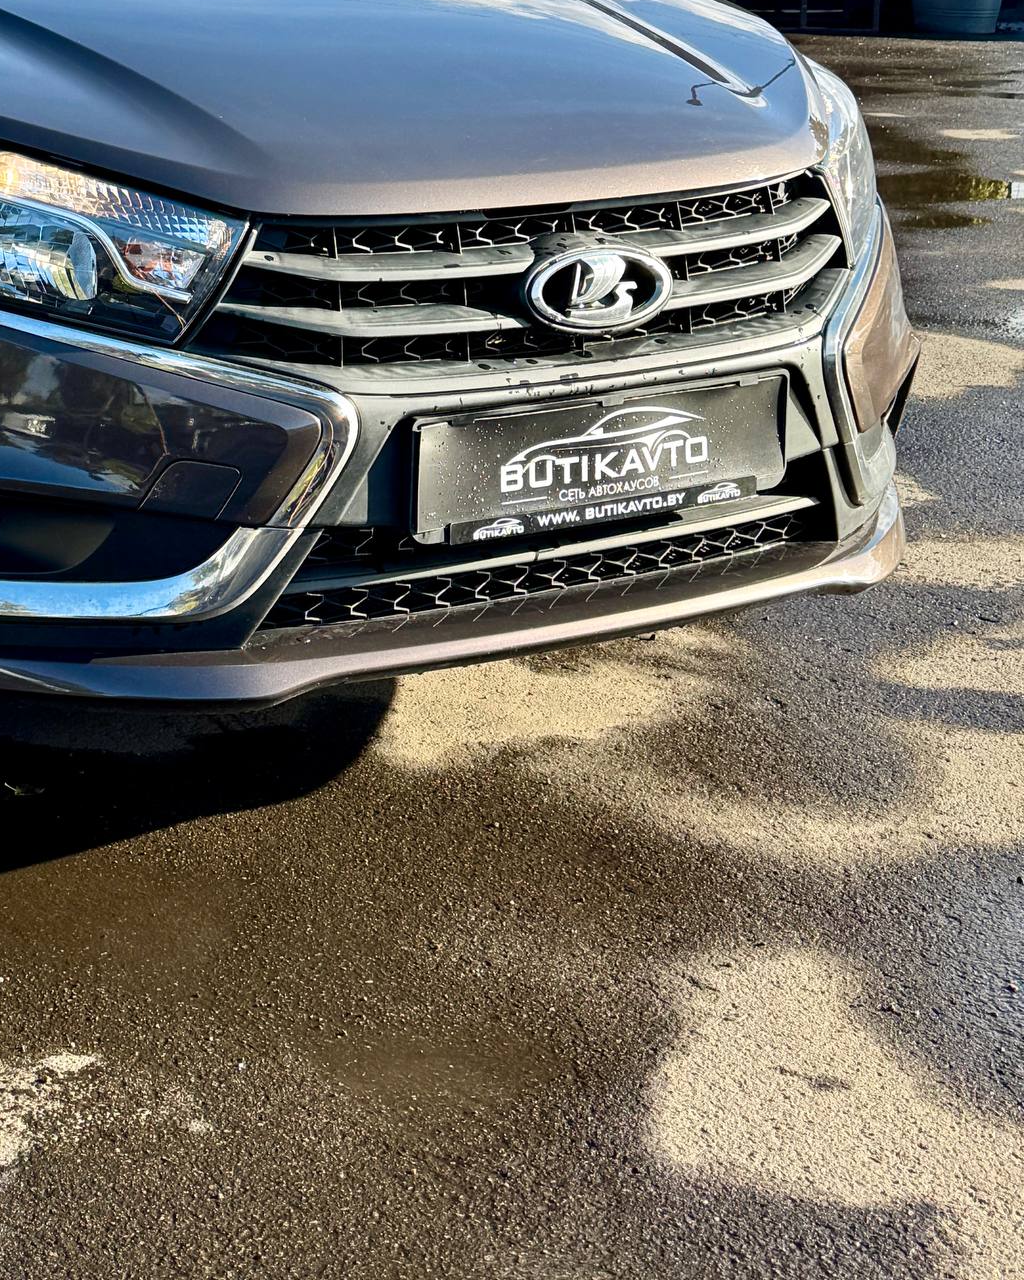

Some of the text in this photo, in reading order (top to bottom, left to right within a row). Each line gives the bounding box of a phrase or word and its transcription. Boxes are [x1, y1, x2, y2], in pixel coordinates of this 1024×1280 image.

[500, 435, 709, 493] BUTIKAVTO
[558, 474, 660, 501] СЕТЬ АВТОХАУСОВ
[537, 492, 686, 527] WWW. BUTIKAVTO.BY
